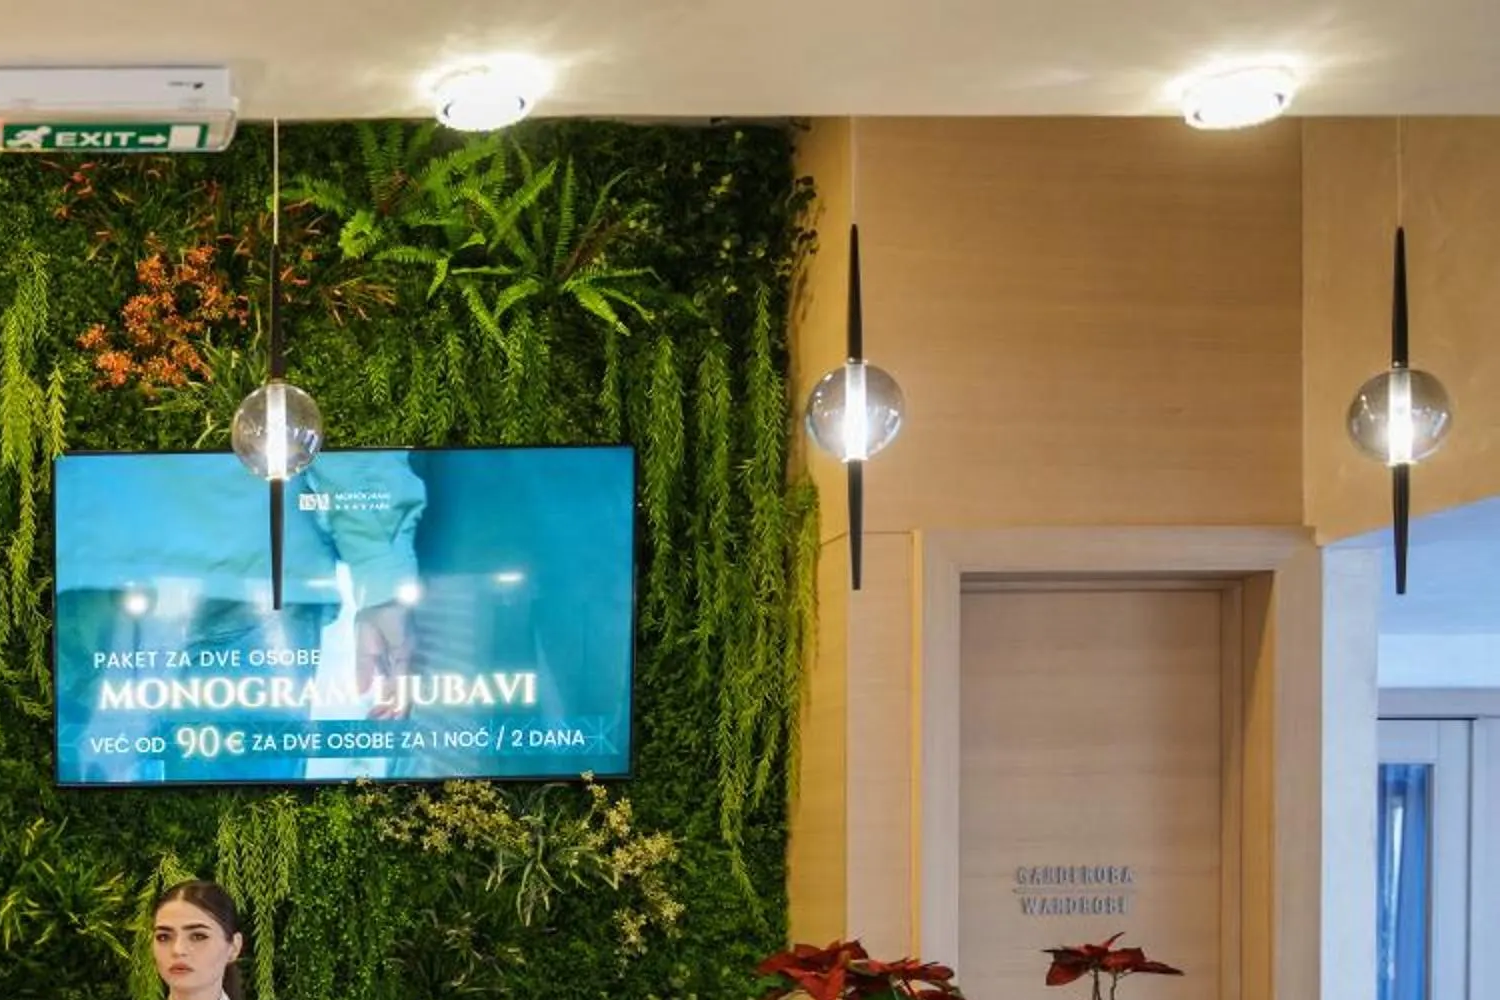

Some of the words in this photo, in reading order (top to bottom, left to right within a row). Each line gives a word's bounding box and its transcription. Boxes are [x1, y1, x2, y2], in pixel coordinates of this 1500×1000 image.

[55, 131, 137, 147] EXIT
[93, 651, 159, 669] PAKET
[166, 651, 192, 668] ZA
[201, 650, 241, 668] DVE
[249, 649, 321, 666] OSOBE
[373, 671, 537, 713] LJUBAVI
[90, 733, 129, 753] VEĆ
[135, 737, 165, 753] OD
[252, 735, 277, 751] ZA
[283, 733, 321, 750] DVE
[327, 732, 394, 749] OSOBE
[401, 732, 425, 748] ZA
[431, 731, 437, 748] 1
[445, 727, 489, 747] NOĆ
[495, 725, 505, 751] /
[511, 730, 523, 747] 2
[529, 729, 585, 747] DANA
